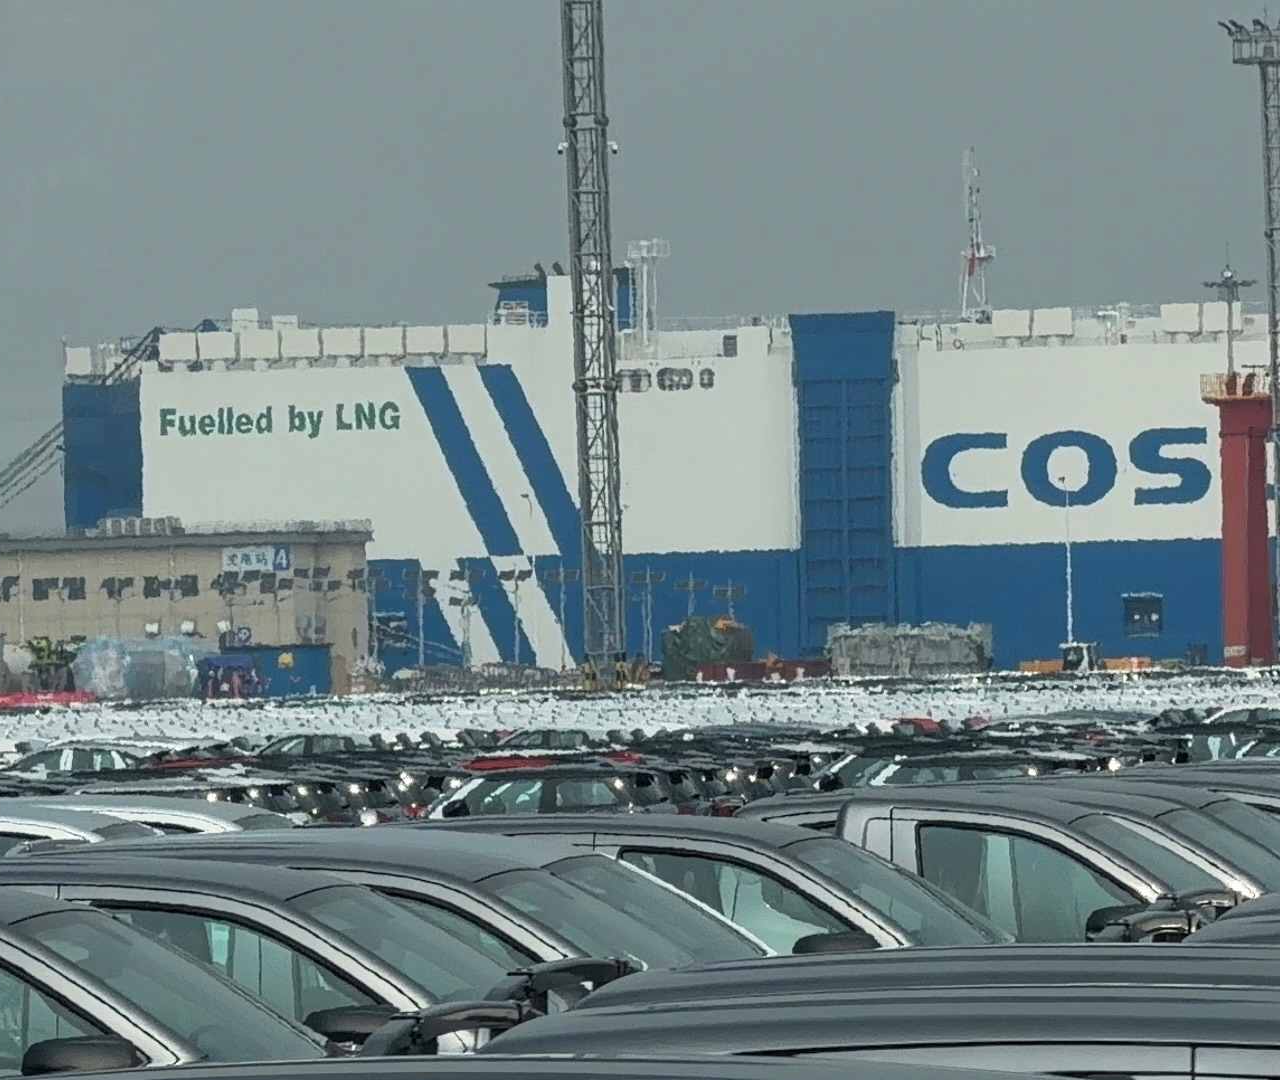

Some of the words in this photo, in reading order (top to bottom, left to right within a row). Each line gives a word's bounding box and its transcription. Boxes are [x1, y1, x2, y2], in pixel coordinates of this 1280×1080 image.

[160, 405, 272, 437] Fuelled
[288, 404, 323, 439] by
[336, 400, 401, 430] LNG
[275, 549, 289, 568] A
